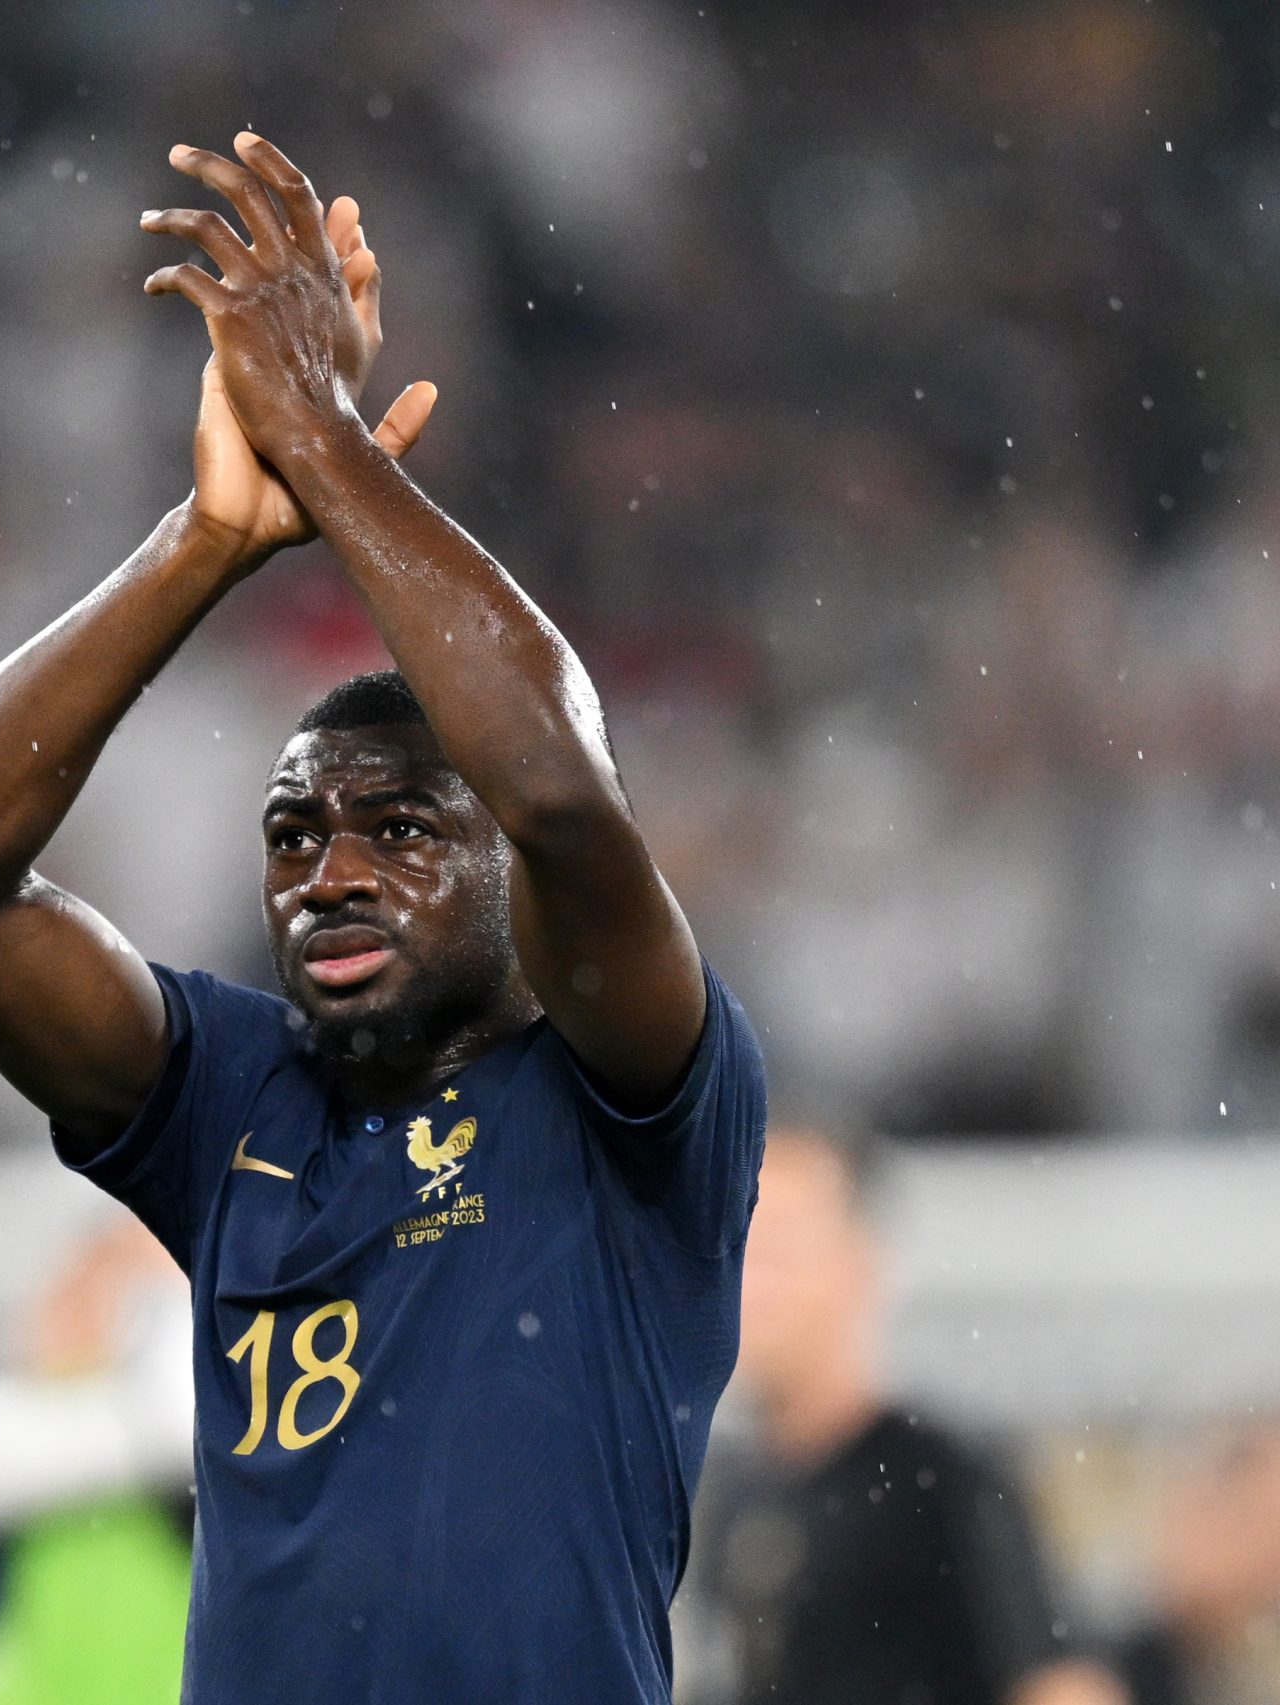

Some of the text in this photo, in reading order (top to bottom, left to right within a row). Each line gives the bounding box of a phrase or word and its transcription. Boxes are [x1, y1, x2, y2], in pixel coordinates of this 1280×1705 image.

[395, 1233, 407, 1248] 12
[451, 1208, 485, 1225] 2023
[226, 1299, 361, 1456] 18
